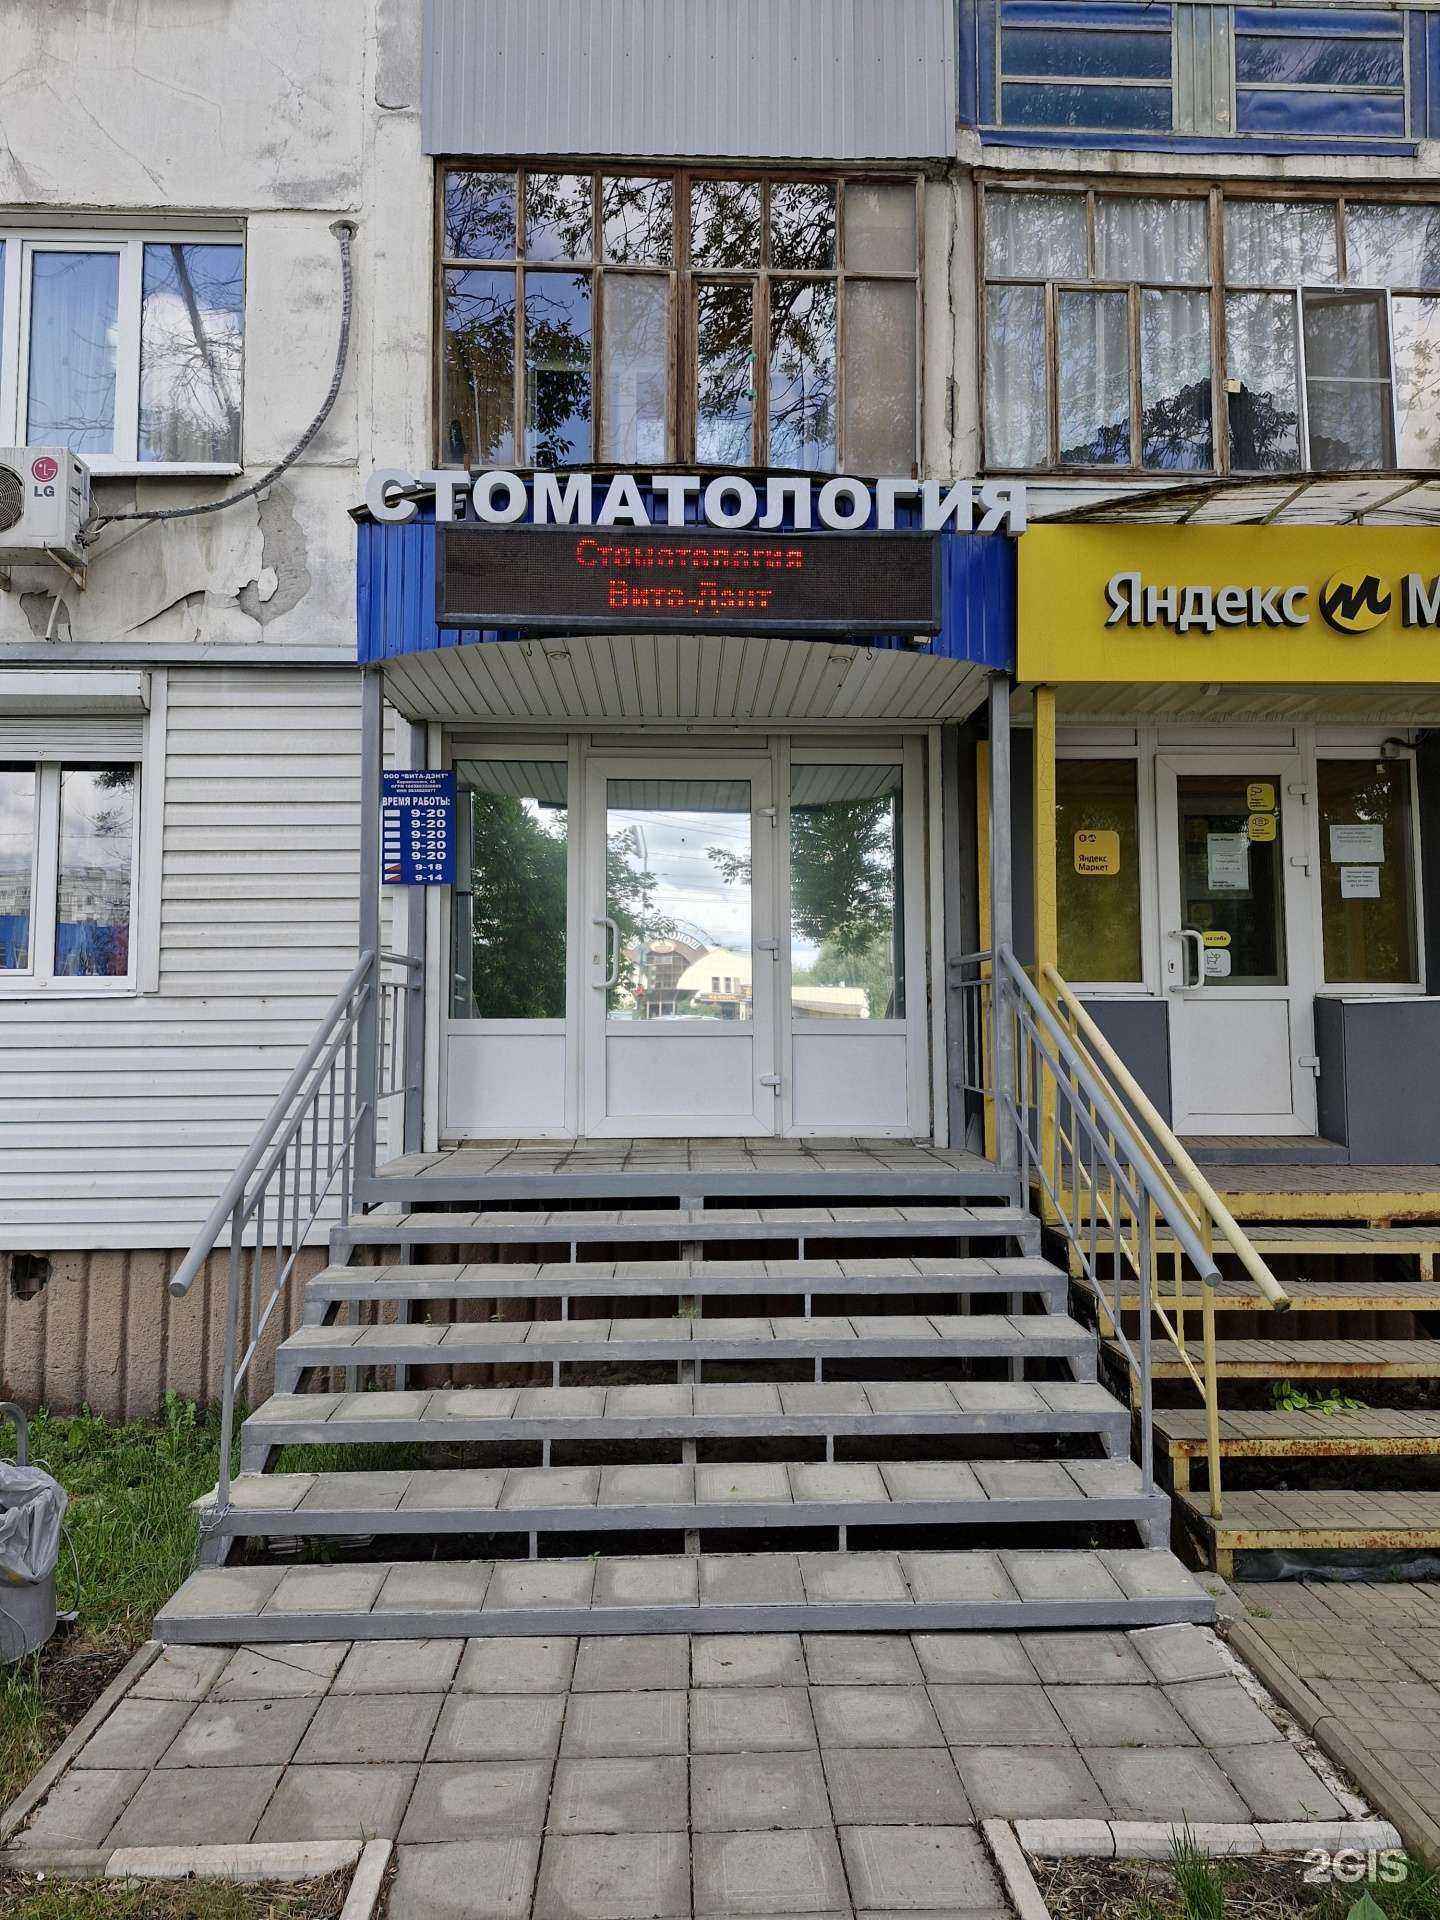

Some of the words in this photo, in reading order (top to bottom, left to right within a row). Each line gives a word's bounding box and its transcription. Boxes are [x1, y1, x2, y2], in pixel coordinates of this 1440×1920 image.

[34, 486, 55, 497] LG
[366, 468, 1027, 535] СТОМАТОЛОГИЯ
[1105, 571, 1310, 633] Яндекс
[382, 796, 411, 806] ВРЕМЯ
[412, 796, 451, 806] РАБОТЫ:
[411, 809, 446, 818] 9-20
[411, 819, 446, 828] 9-20
[411, 830, 446, 839] 9-20
[411, 841, 446, 849] 9-20
[411, 851, 446, 860] 9-20
[1078, 854, 1107, 863] Яндекс
[415, 863, 443, 871] 9-18
[1078, 863, 1108, 871] Маркет
